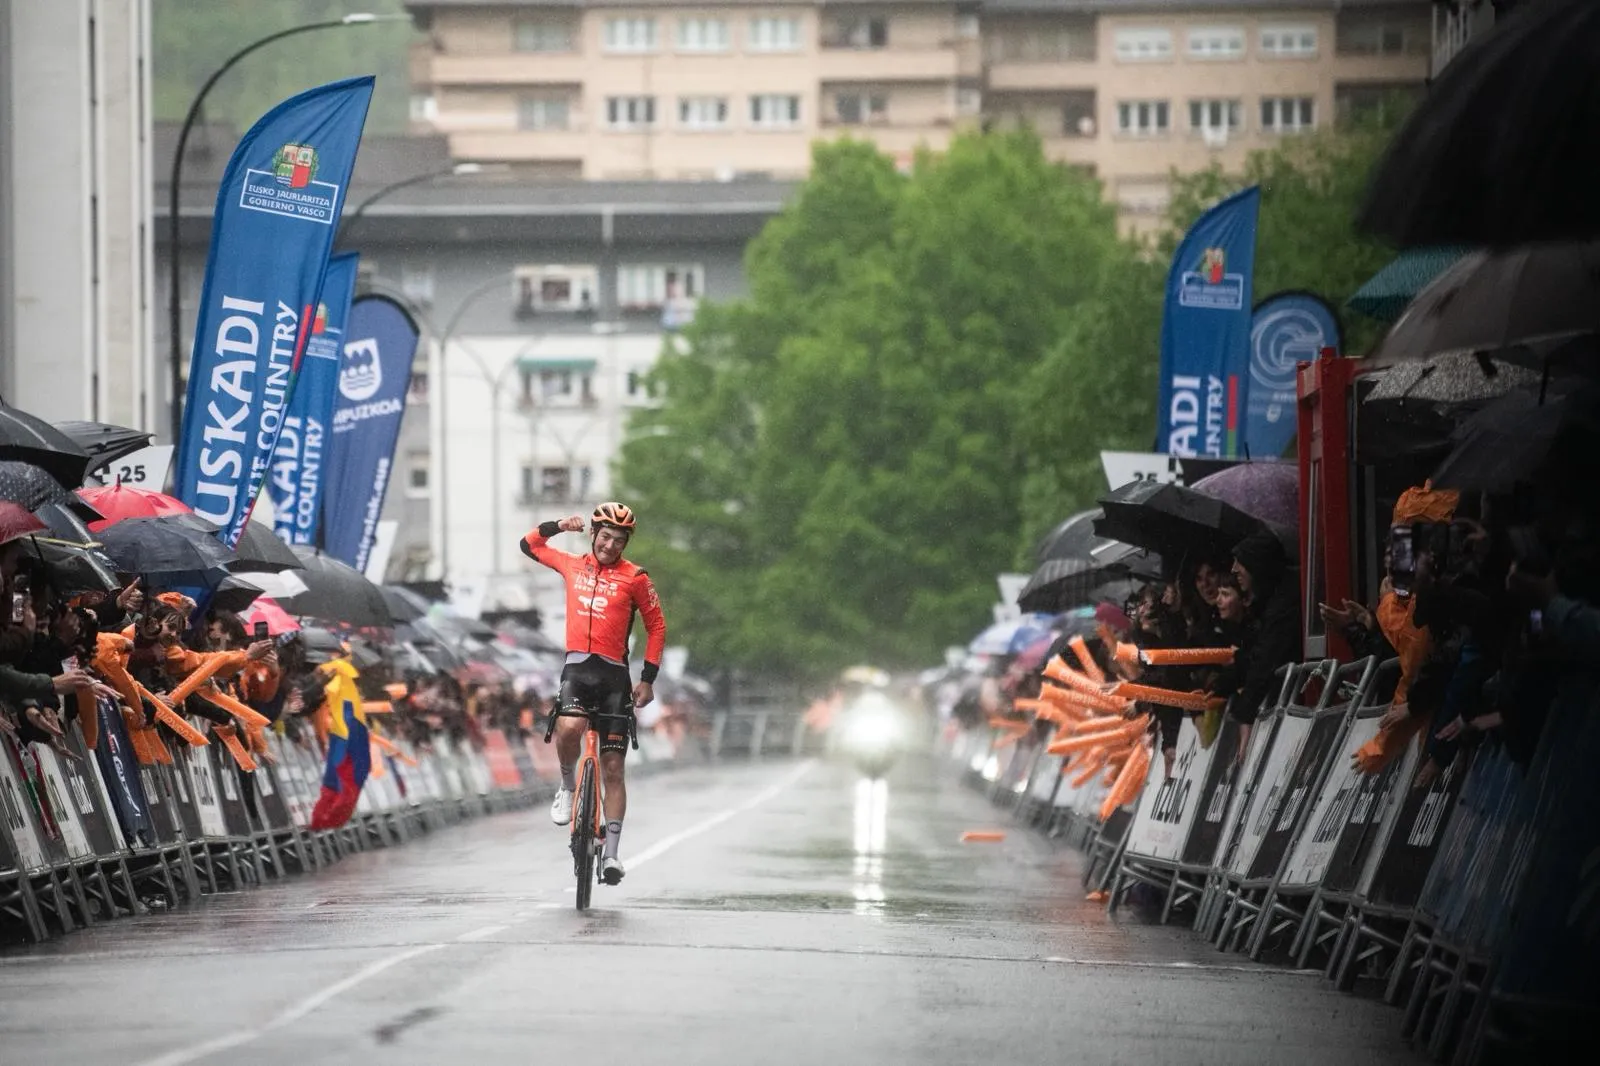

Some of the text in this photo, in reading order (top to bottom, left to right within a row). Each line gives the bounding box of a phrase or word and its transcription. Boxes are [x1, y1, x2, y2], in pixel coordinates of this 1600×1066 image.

[248, 184, 330, 207] EUSKO JAURLARITZA
[248, 196, 325, 218] GOBIERNO VASCO
[257, 300, 298, 450] COUNTRY
[194, 295, 264, 526] USKADI
[120, 465, 146, 483] 25
[296, 417, 323, 529] COUNTRY
